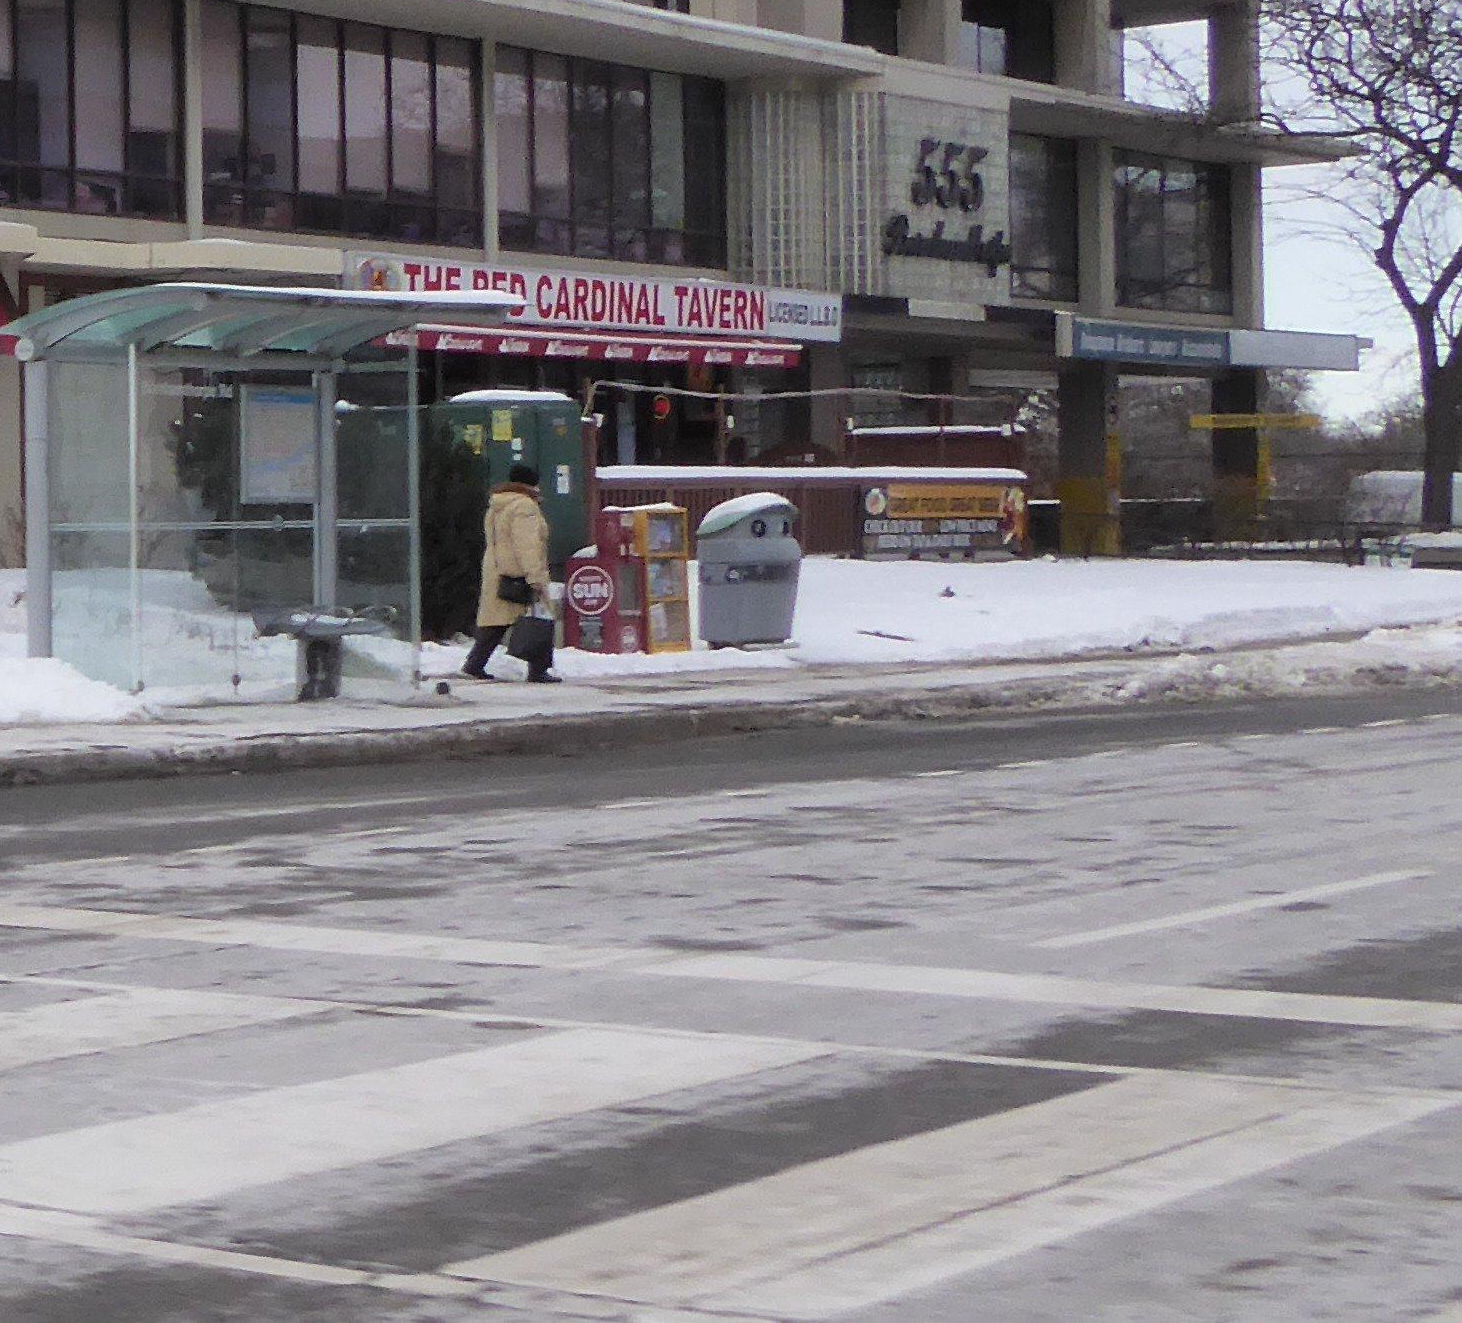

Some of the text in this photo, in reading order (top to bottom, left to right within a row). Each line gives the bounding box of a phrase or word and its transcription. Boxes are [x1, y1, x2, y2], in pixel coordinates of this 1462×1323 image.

[911, 137, 989, 213] 555
[536, 275, 666, 326] CARDINAL
[674, 285, 766, 331] TAVERN
[573, 582, 609, 599] SUN
